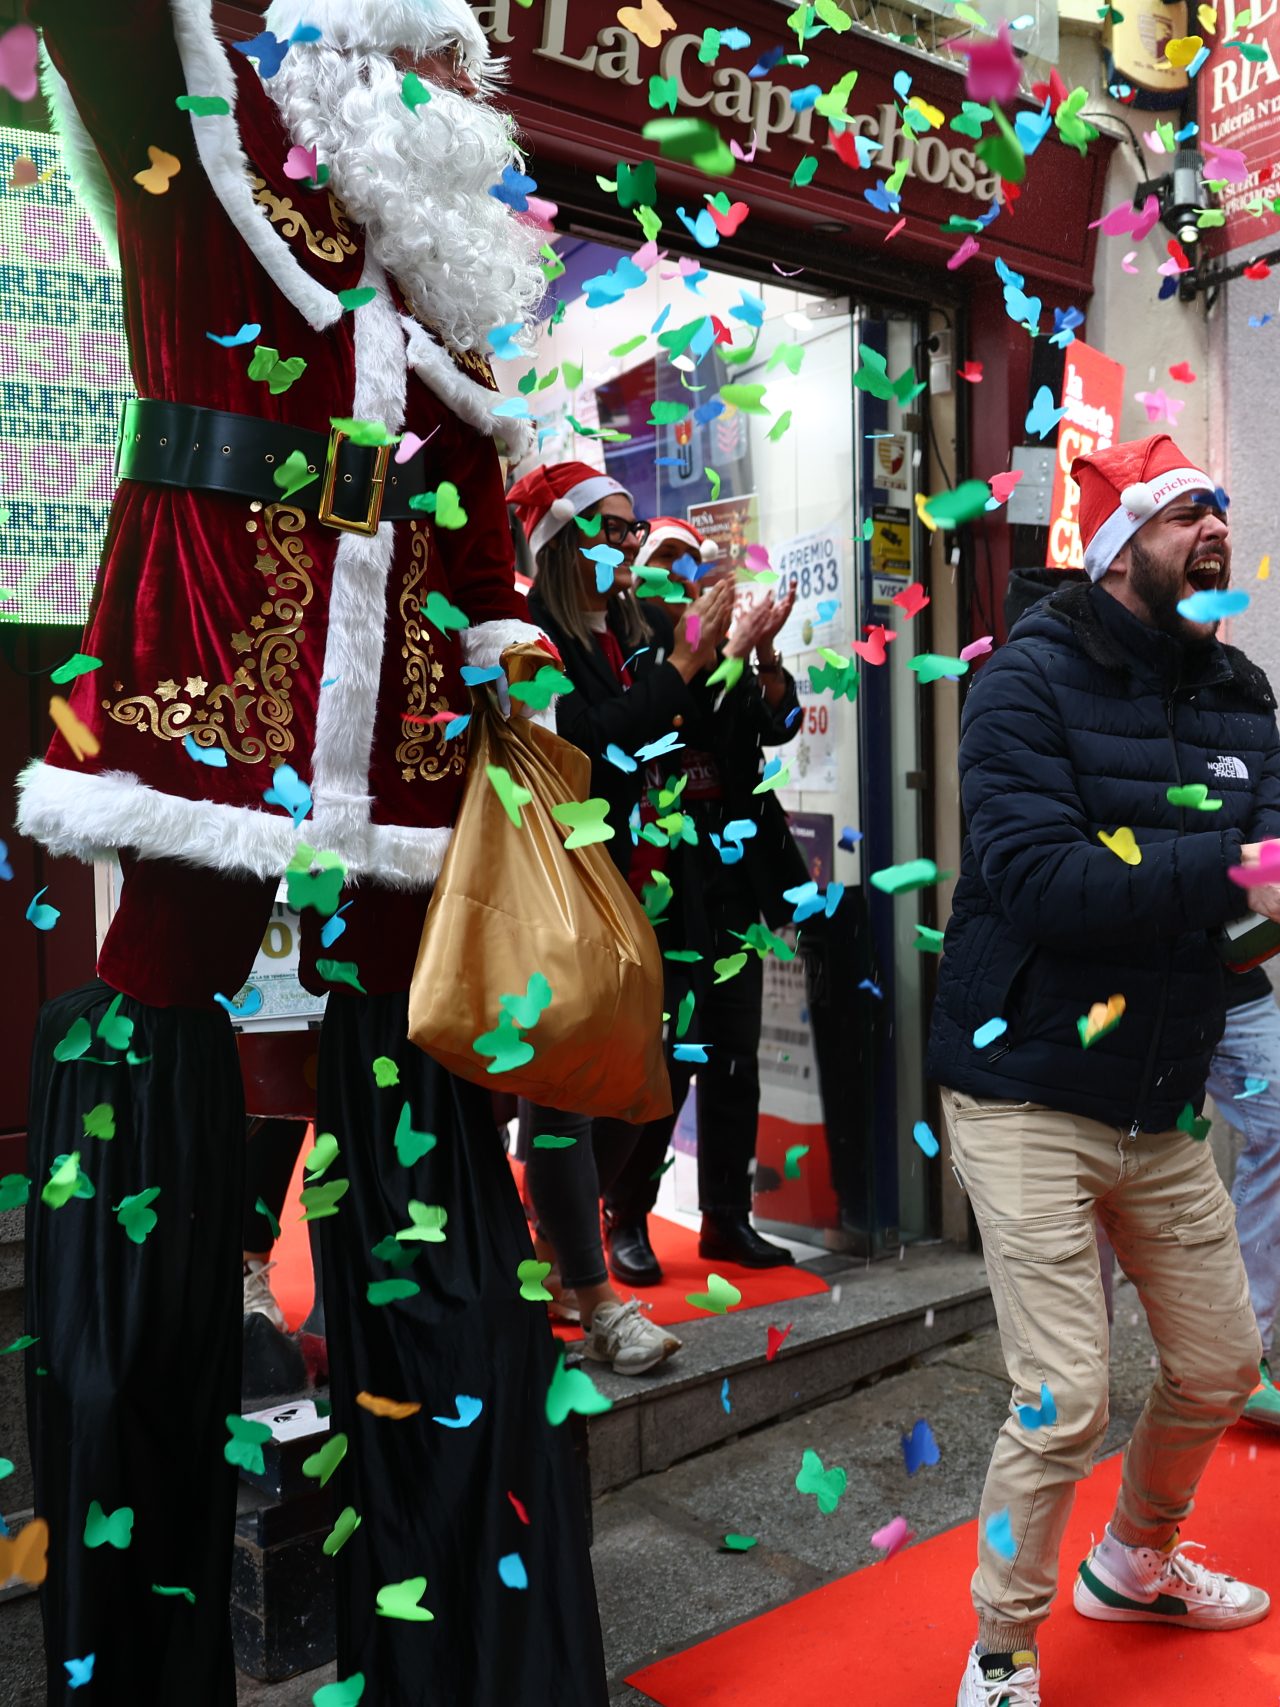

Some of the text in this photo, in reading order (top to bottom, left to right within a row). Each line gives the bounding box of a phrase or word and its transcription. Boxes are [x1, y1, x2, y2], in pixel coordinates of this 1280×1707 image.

[532, 0, 1006, 204] La Caprchosa
[789, 539, 834, 566] PREMIO
[1217, 755, 1233, 763] THE
[1207, 761, 1235, 771] NORTH
[1216, 769, 1236, 778] FACE
[986, 1667, 1005, 1678] NIKE
